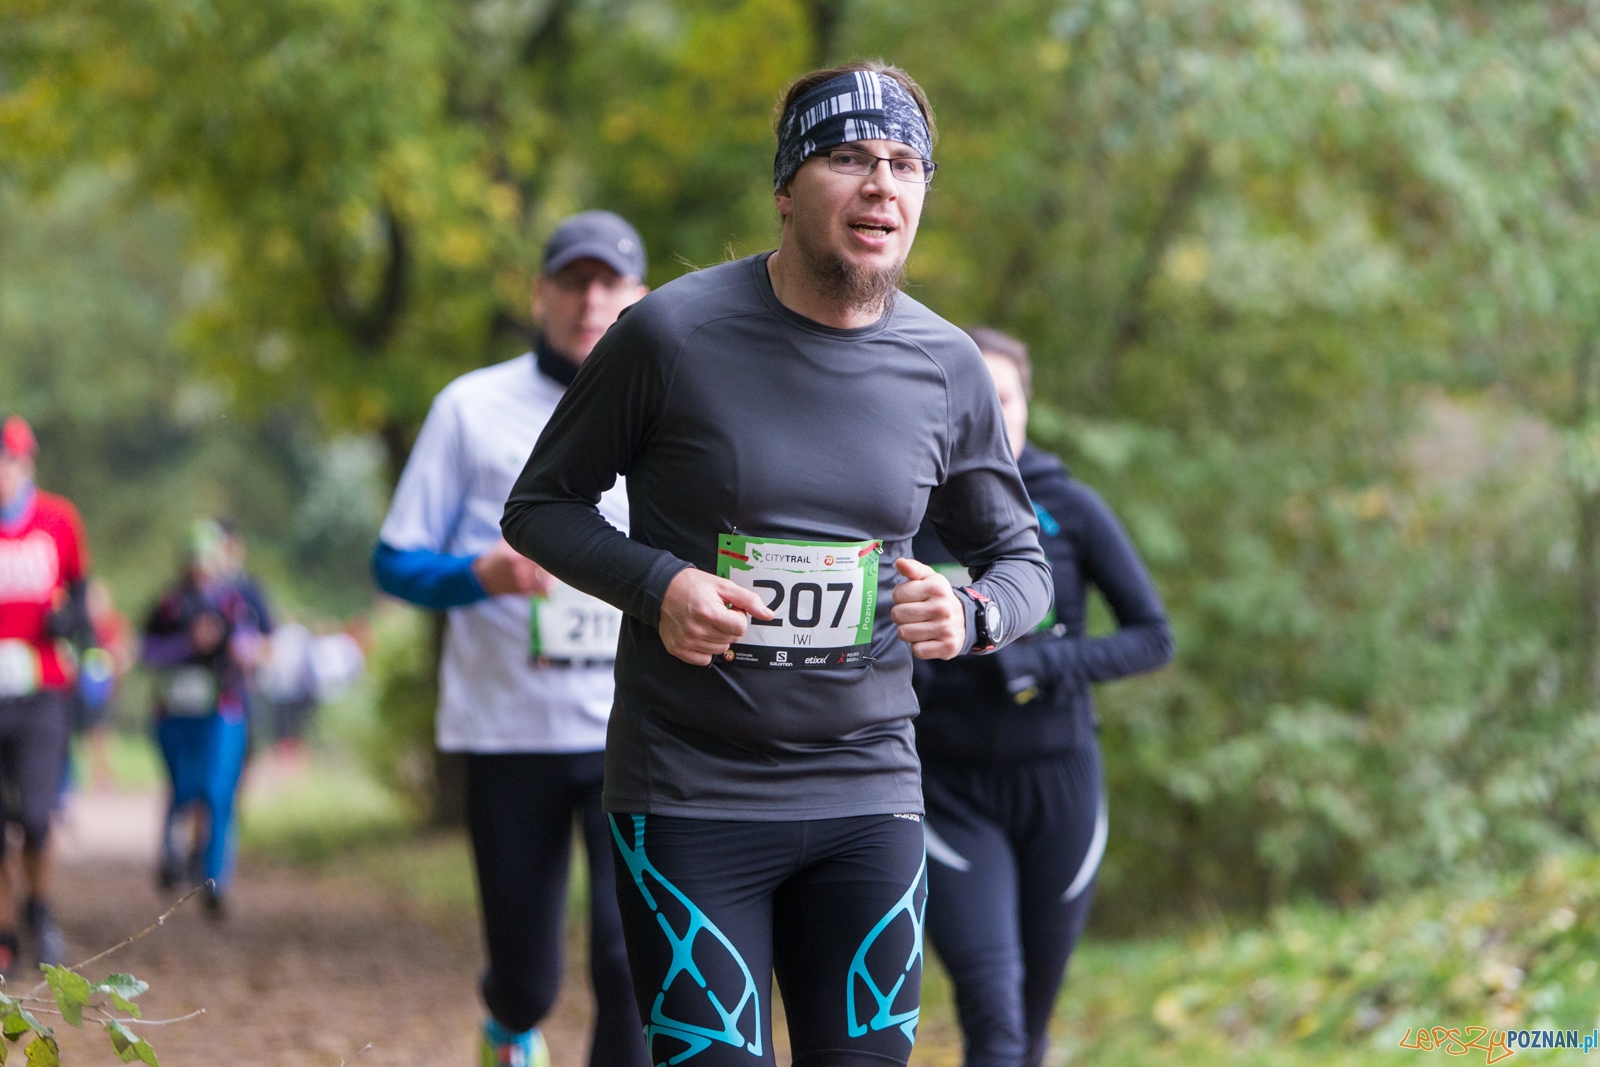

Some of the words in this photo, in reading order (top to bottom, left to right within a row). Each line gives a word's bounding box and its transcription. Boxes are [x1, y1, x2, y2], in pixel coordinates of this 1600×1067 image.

[751, 579, 854, 628] 207
[862, 590, 873, 630] Poznań
[793, 634, 812, 645] IWI
